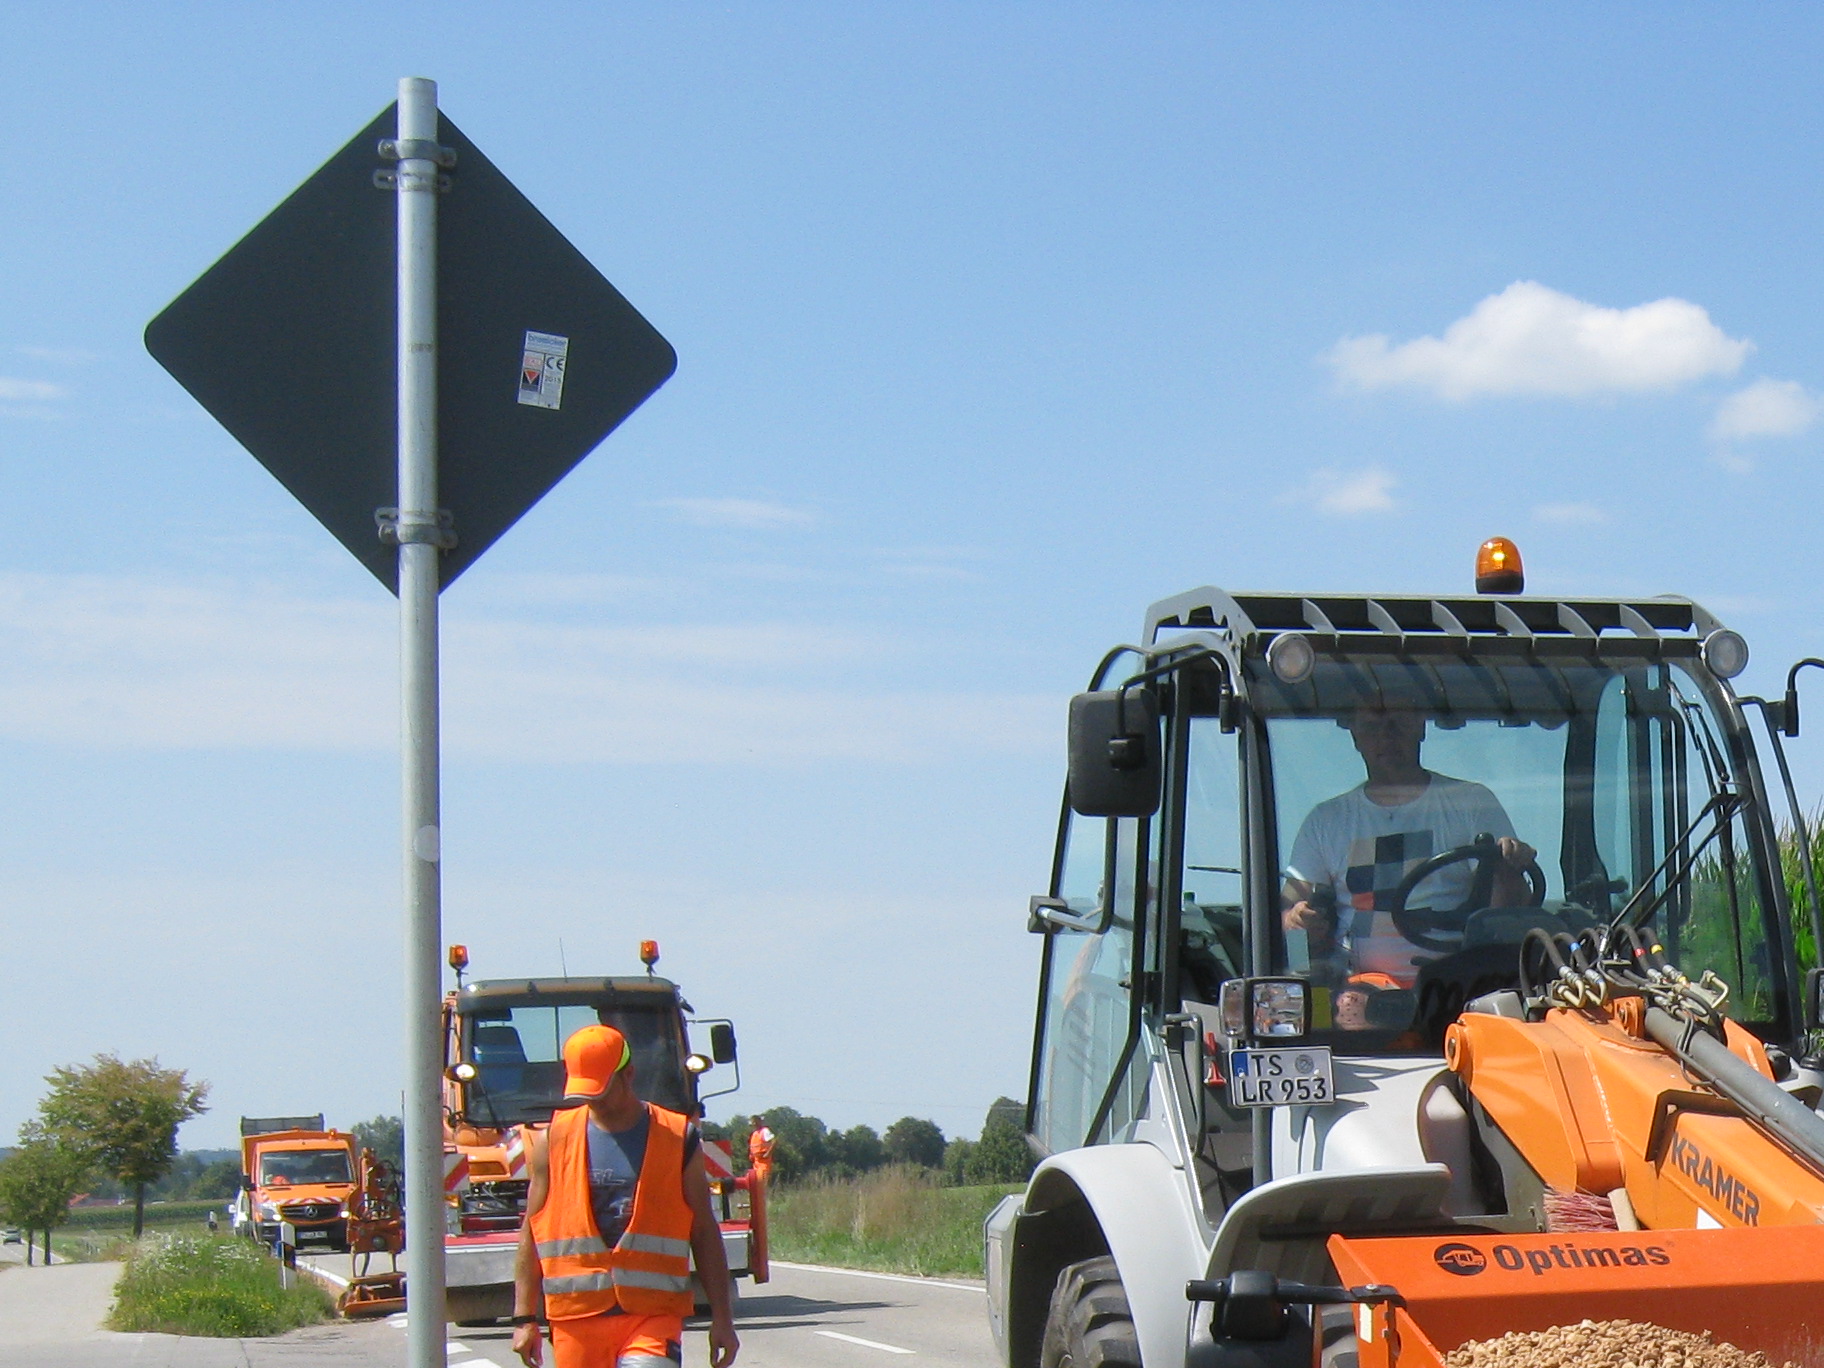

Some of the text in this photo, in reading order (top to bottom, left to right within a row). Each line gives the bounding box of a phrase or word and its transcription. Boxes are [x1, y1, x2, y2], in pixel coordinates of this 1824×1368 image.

[546, 357, 564, 371] CE
[1251, 1054, 1282, 1076] TS
[1241, 1078, 1326, 1102] LR 953
[1671, 1131, 1760, 1227] KRAMER
[1492, 1243, 1671, 1275] Optimas
